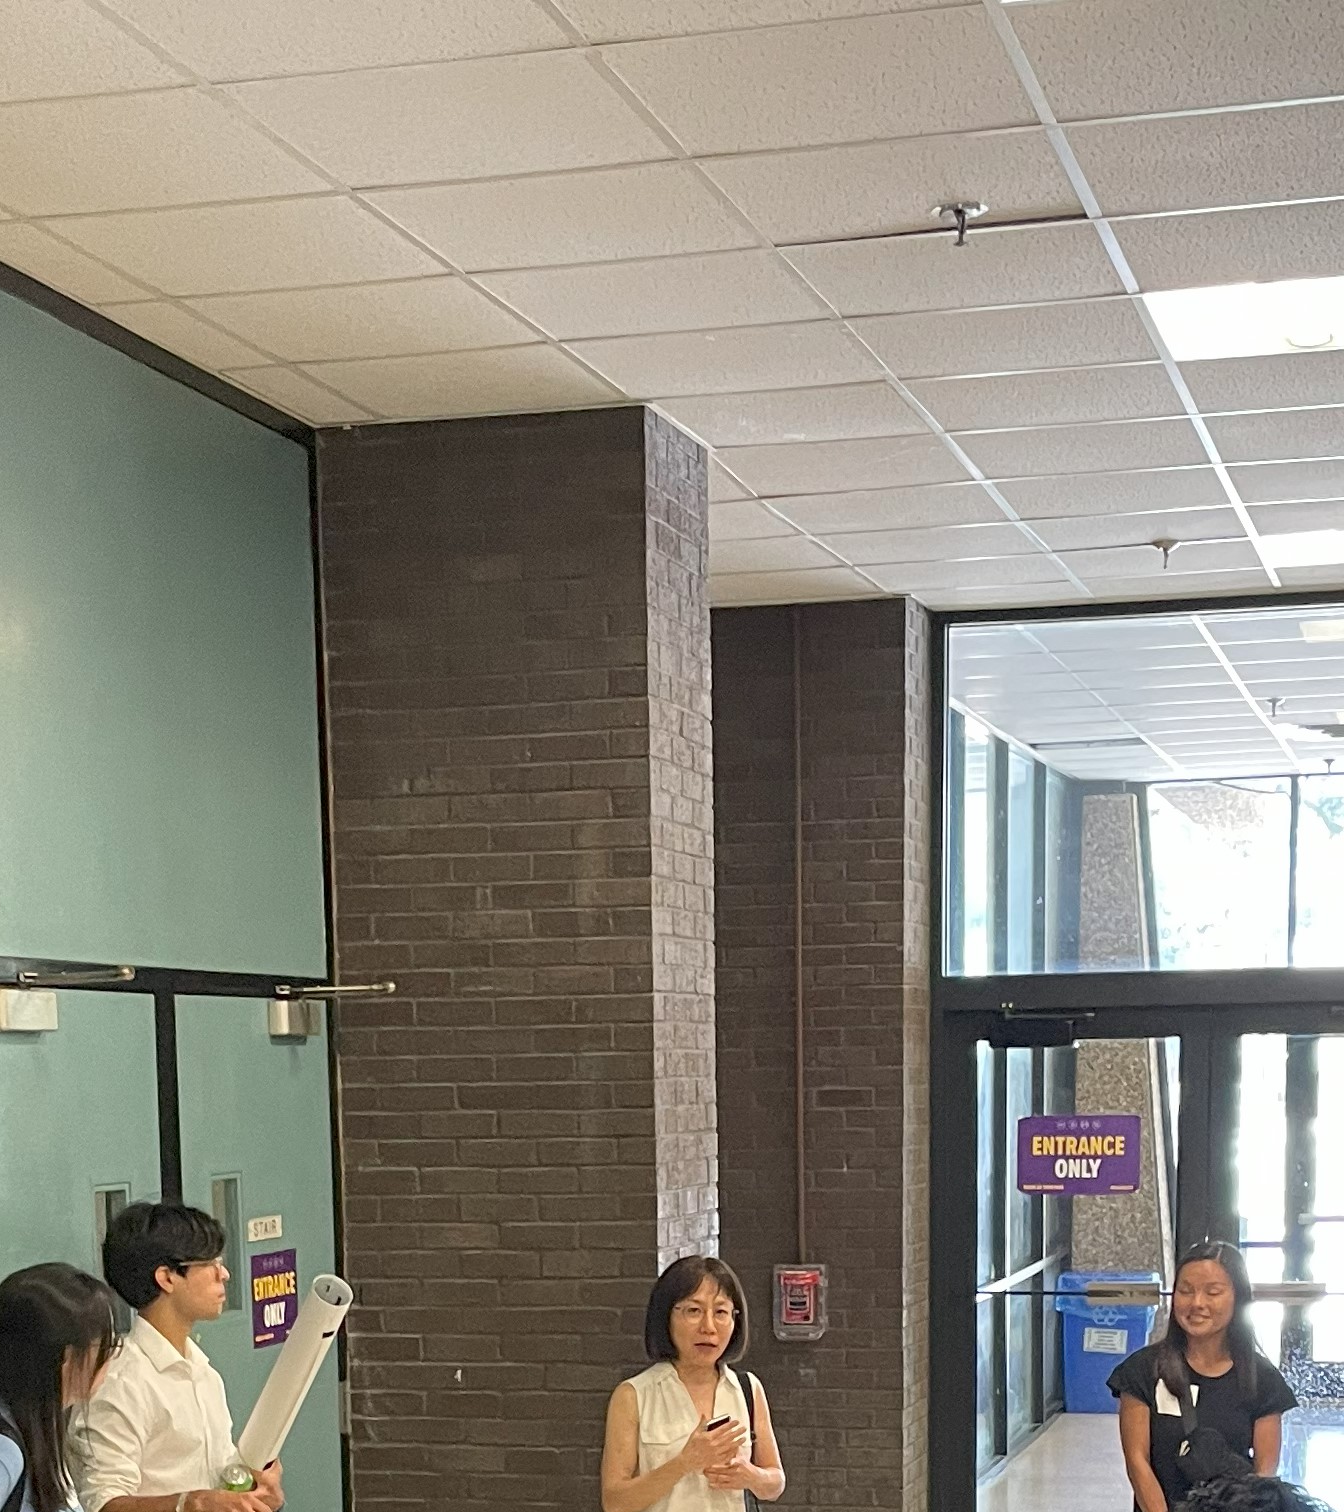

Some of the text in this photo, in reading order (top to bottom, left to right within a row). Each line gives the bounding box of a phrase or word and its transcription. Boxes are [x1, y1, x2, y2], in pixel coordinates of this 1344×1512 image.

[1032, 1135, 1125, 1156] ENTRANCE
[1054, 1158, 1102, 1179] ONLY
[253, 1219, 277, 1238] STAIR
[253, 1271, 295, 1302] ENTRANCE
[263, 1301, 286, 1328] ONLY
